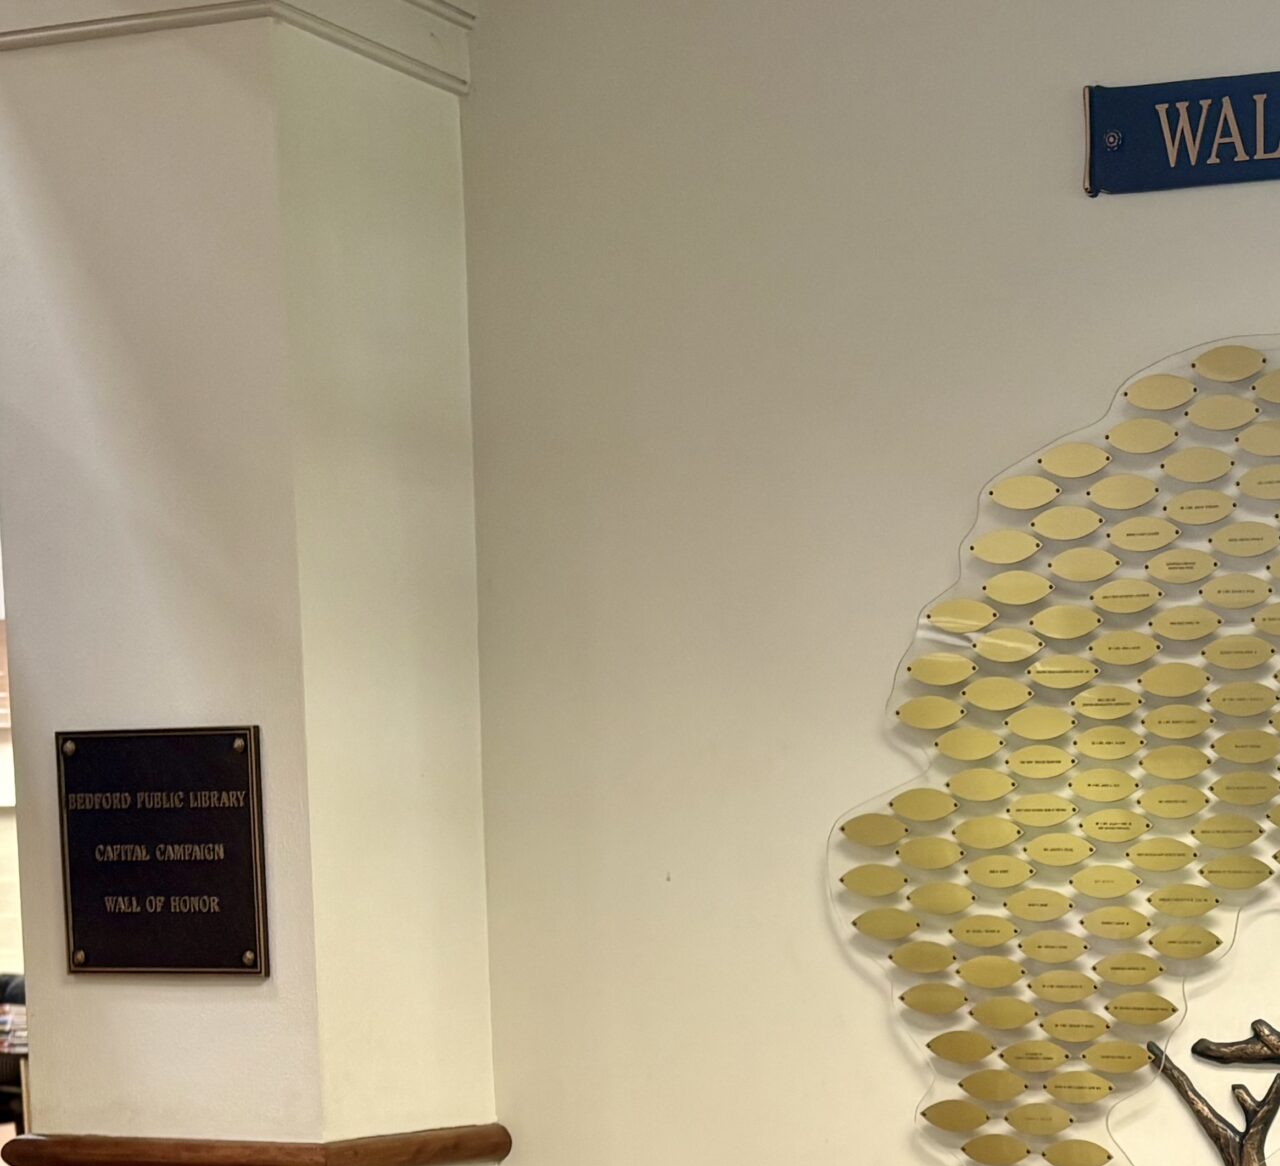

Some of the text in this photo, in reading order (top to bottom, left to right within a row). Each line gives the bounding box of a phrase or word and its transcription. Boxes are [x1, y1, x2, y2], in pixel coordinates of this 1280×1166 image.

[68, 790, 246, 810] BEDFORD PUBLIC LIBRARY
[95, 843, 225, 862] CAPITAL CAMPAIGN
[104, 895, 220, 913] WALL OF HONOR
